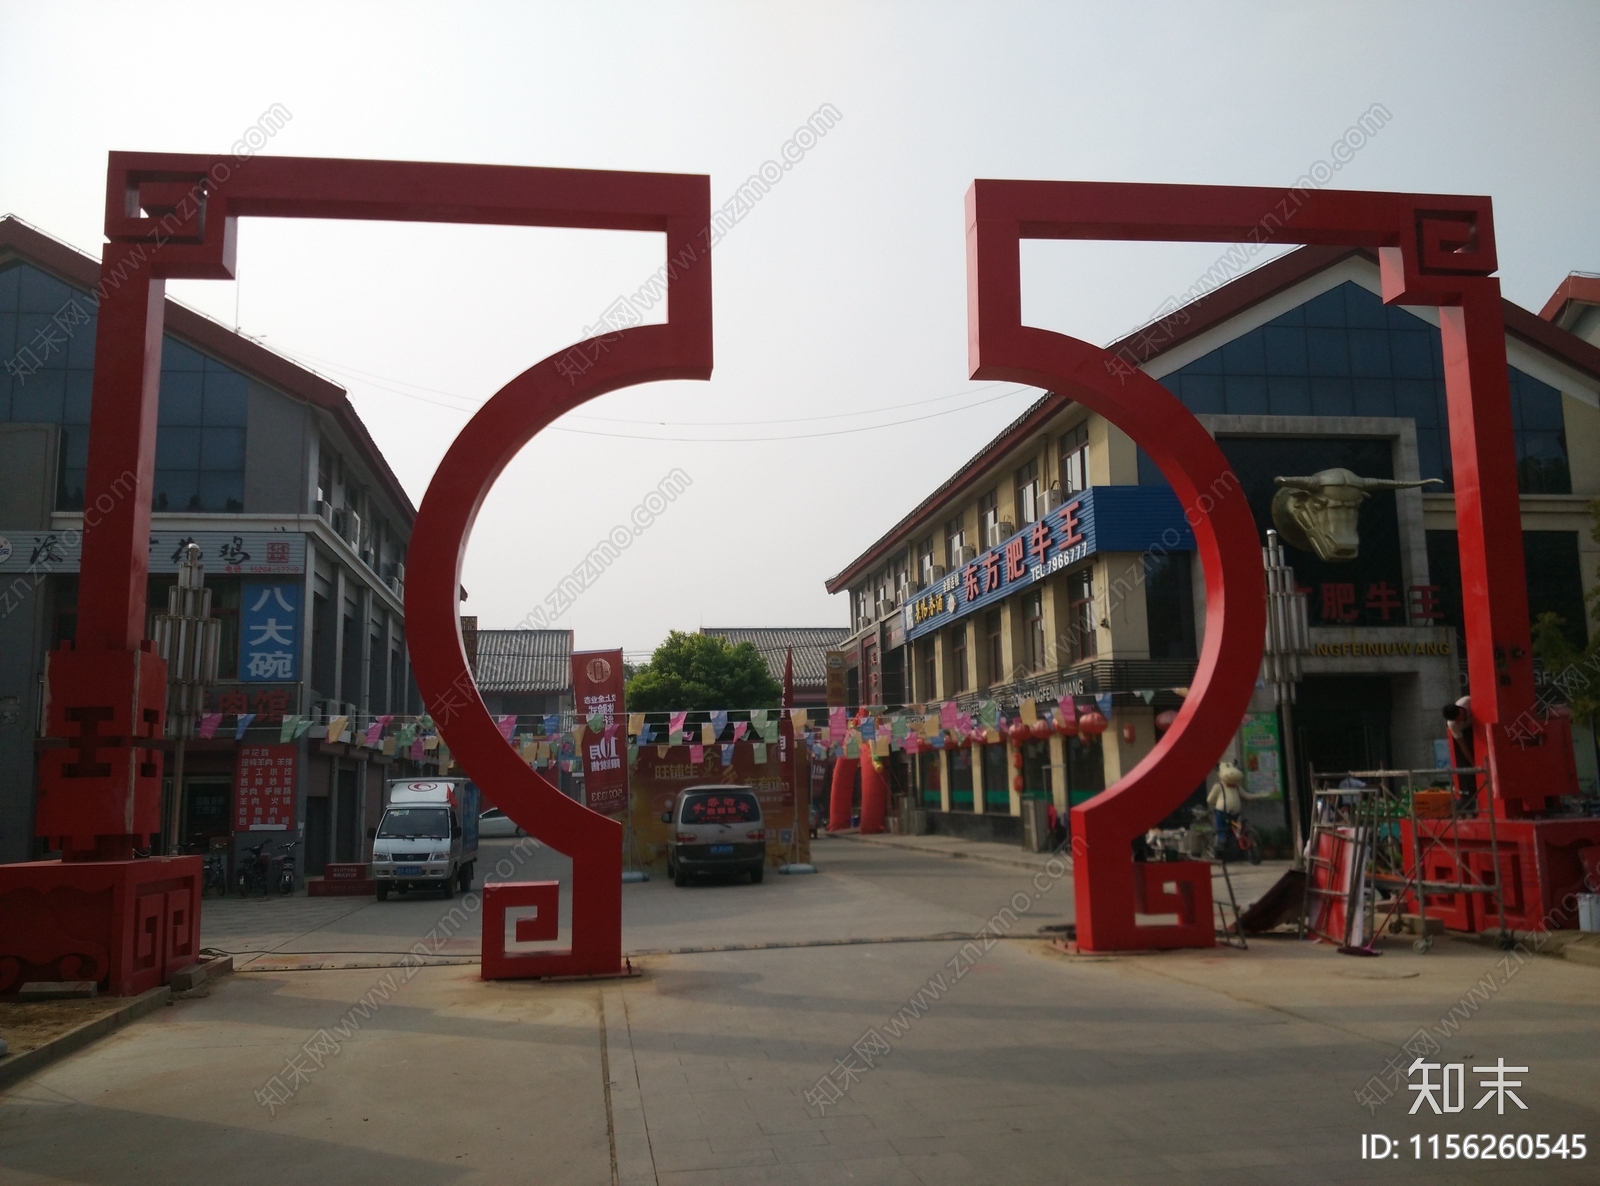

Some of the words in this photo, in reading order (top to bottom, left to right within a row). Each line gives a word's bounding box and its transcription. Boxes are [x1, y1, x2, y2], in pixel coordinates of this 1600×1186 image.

[963, 500, 1083, 602] 东方肥牛王
[247, 587, 295, 679] 八大碗
[1294, 580, 1445, 621] 肥牛王
